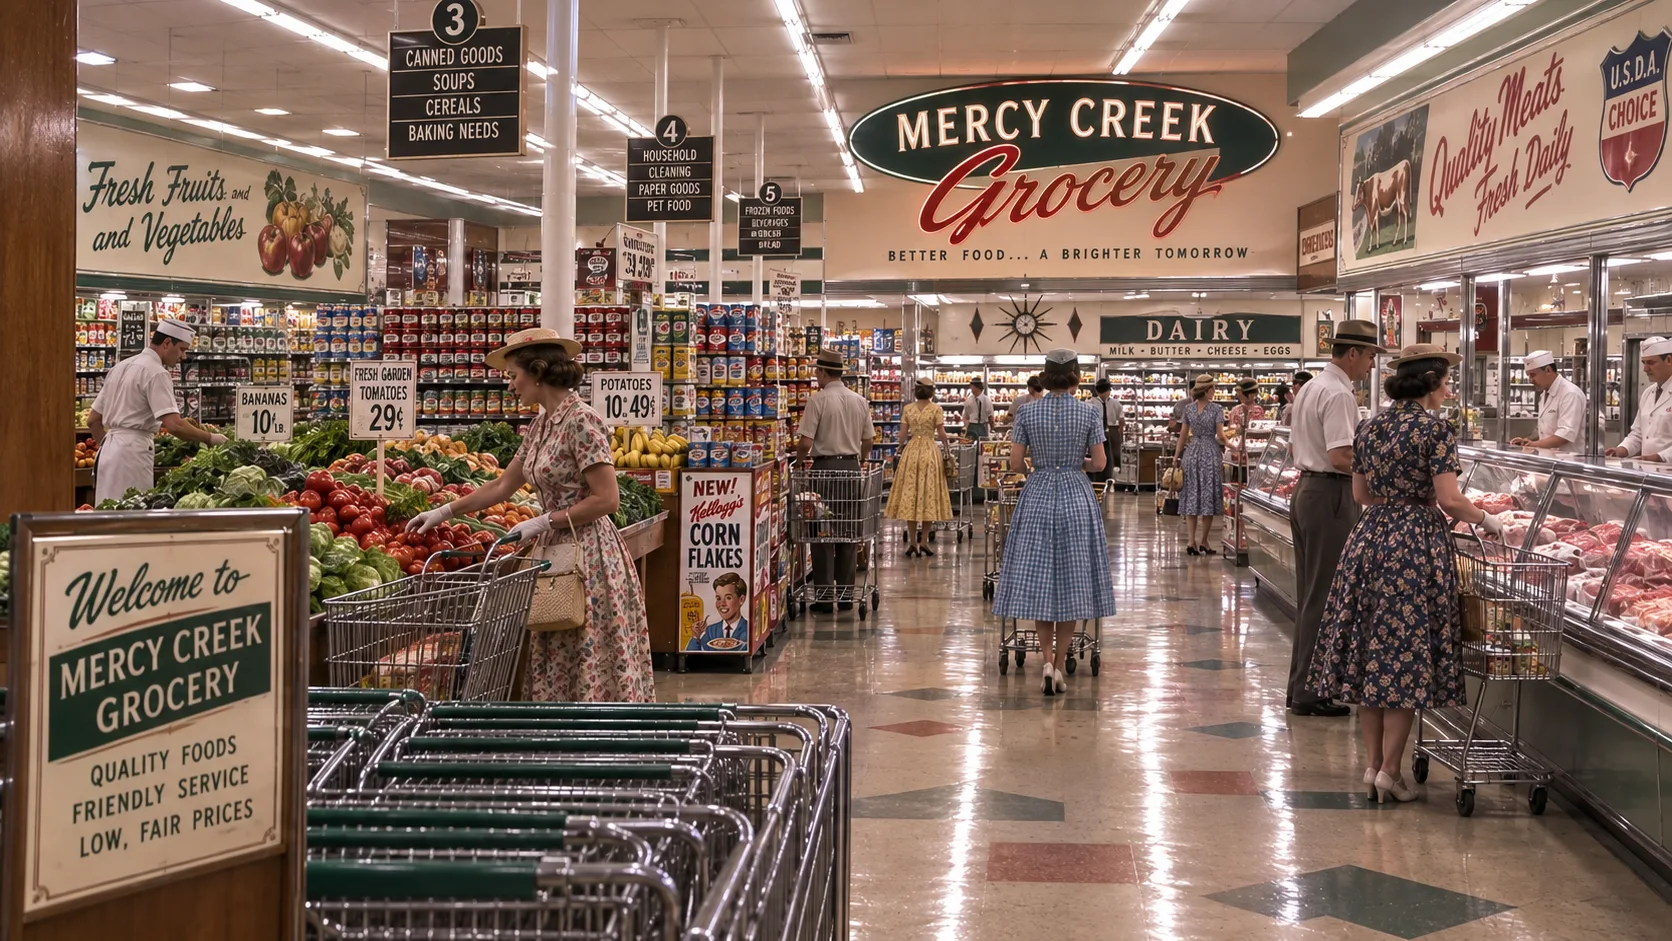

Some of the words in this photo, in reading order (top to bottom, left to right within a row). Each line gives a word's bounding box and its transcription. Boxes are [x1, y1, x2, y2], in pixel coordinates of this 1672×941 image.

[445, 3, 465, 36] 3
[406, 48, 455, 67] CANNED
[460, 46, 503, 65] GOODS
[433, 72, 475, 91] SOUPS
[1611, 50, 1660, 90] U.S.D.A.
[426, 97, 481, 116] CEREALS
[1609, 89, 1658, 131] CHOICE
[409, 123, 454, 142] BAKING
[459, 121, 499, 139] NEEDS
[663, 120, 678, 143] 4
[896, 98, 1049, 152] MERCY
[1070, 97, 1217, 144] CREEK
[643, 149, 697, 162] HOUSEHOLD
[1429, 107, 1498, 217] Quality
[648, 166, 691, 179] CLEANING
[83, 161, 155, 213] Fresh
[231, 185, 251, 200] and
[638, 183, 666, 196] PAPER
[670, 182, 700, 194] GOODS
[765, 186, 776, 202] 5
[918, 144, 1225, 246] Grocery
[1474, 147, 1519, 237] Fresh
[647, 200, 664, 212] PET
[667, 199, 691, 211] FOOD
[93, 217, 135, 251] and
[141, 205, 247, 265] Vegetables
[888, 250, 947, 262] BETTER
[962, 249, 1029, 262] FOOD...
[1039, 249, 1049, 261] A
[1061, 247, 1142, 260] BRIGHTER
[1155, 247, 1248, 260] TOMORROW
[1146, 319, 1255, 341] DAIRY
[1109, 347, 1135, 355] MILK
[1150, 346, 1191, 355] BUTTER
[1207, 346, 1247, 355] CHEESE
[1263, 346, 1291, 355] EGGS
[355, 367, 378, 381] FRESH
[601, 378, 652, 391] POTATOES
[242, 392, 287, 406] BANANAS
[693, 477, 738, 497] NEW!
[689, 494, 744, 523] Kellogg's
[690, 522, 740, 546] CORN
[688, 548, 743, 569] FLAKES
[65, 562, 204, 630] Welcome
[213, 559, 251, 595] to
[60, 636, 164, 700] MERCY
[173, 614, 263, 664] CREEK
[96, 661, 240, 733] GROCERY
[90, 749, 170, 787] QUALITY
[182, 735, 237, 765] FOODS
[73, 783, 165, 824] FRIENDLY
[178, 764, 249, 799] SERVICE
[79, 828, 128, 858] LOW,
[140, 814, 181, 843] FAIR
[193, 798, 253, 830] PRICES
